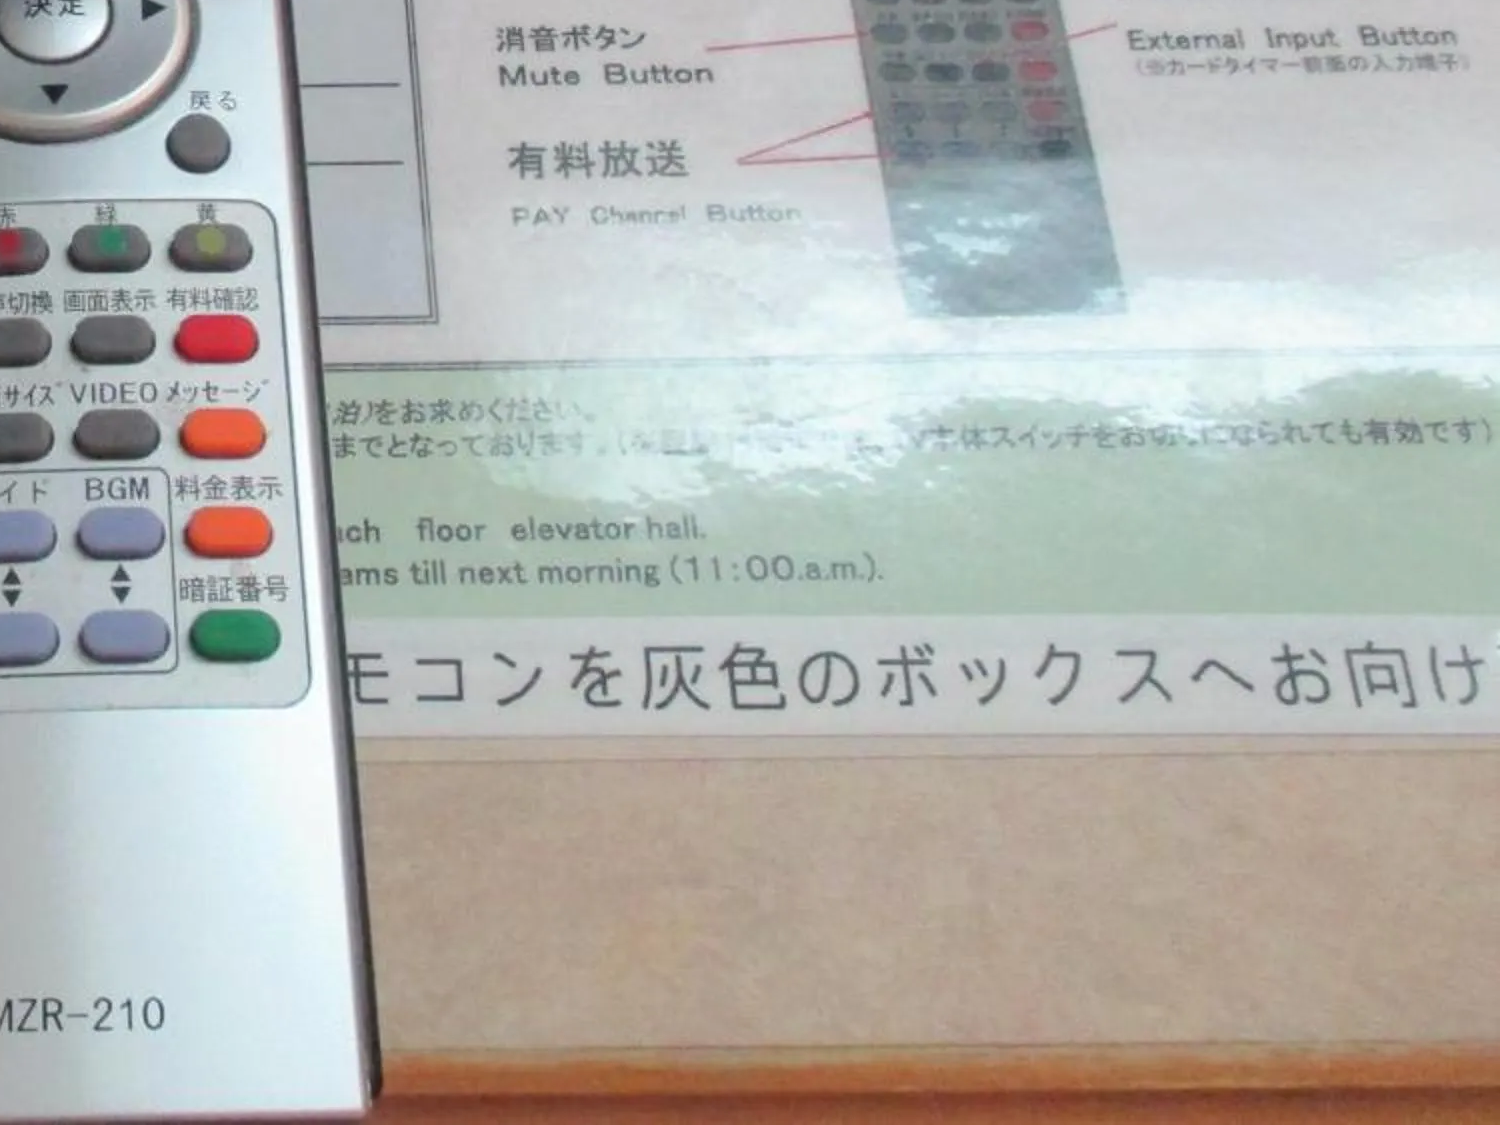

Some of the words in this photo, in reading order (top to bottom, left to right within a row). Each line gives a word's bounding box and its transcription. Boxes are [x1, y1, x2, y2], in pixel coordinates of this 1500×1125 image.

[496, 25, 646, 53] 消音ボタン
[1127, 27, 1245, 50] External
[1265, 25, 1340, 50] Input
[1359, 24, 1458, 46] Button
[498, 65, 581, 88] Mute
[604, 63, 714, 85] Button
[189, 90, 238, 111] 戻る
[507, 139, 690, 179] 有料放送
[95, 204, 118, 225] 緑
[511, 206, 570, 226] PAY
[706, 203, 802, 223] Button
[63, 288, 156, 314] 画面表示
[166, 286, 259, 312] 有料確認
[69, 381, 158, 404] VIDEO
[166, 378, 271, 405] メッセージ
[84, 478, 150, 502] BGM
[173, 475, 284, 501] 料金表示
[417, 516, 487, 543] floor
[511, 515, 636, 542] elevator
[646, 513, 707, 541] hall.
[340, 566, 400, 587] ams
[410, 559, 447, 586] till
[459, 561, 529, 585] next
[538, 558, 661, 587] morning
[178, 575, 290, 604] 暗証番号
[346, 640, 1485, 711] モコンを灰色のボックスへお向け
